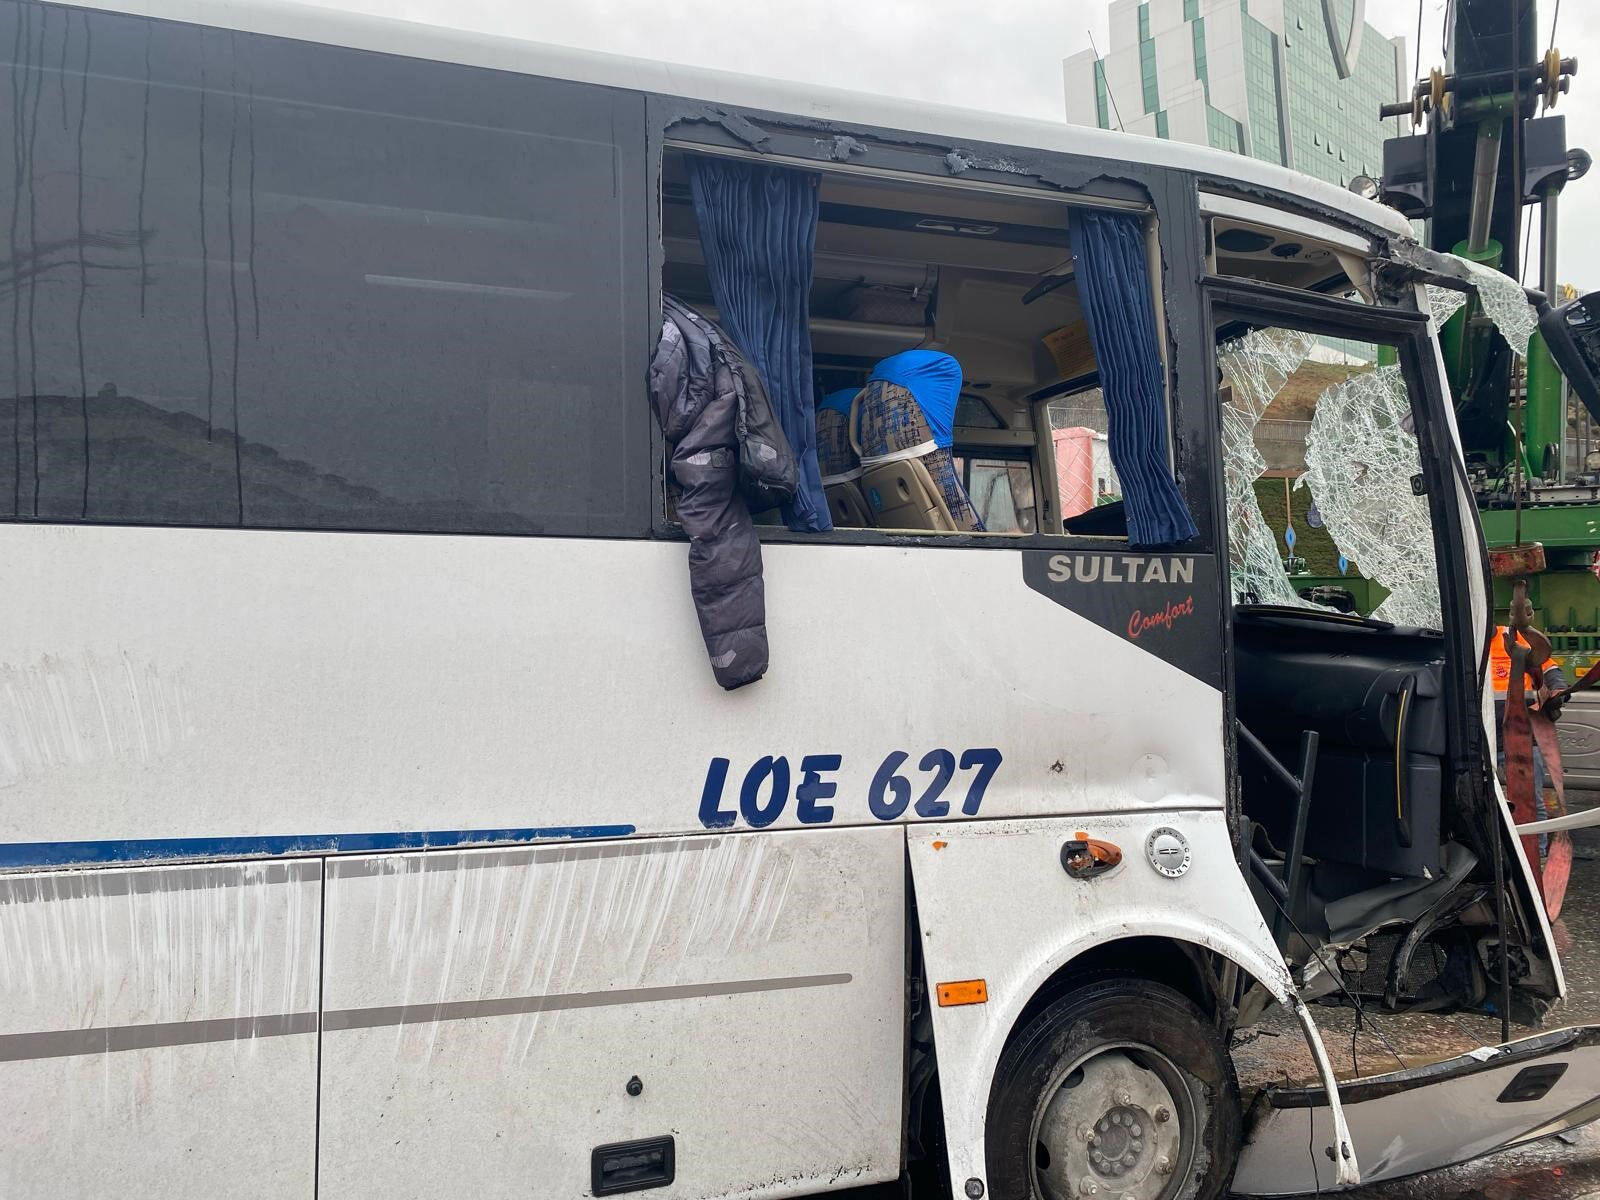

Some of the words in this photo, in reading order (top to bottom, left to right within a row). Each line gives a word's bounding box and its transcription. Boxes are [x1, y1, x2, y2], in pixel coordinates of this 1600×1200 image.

[1047, 554, 1194, 583] SULTAN
[1127, 595, 1195, 639] Comfort
[698, 754, 842, 829] LOE
[868, 748, 1002, 820] 627
